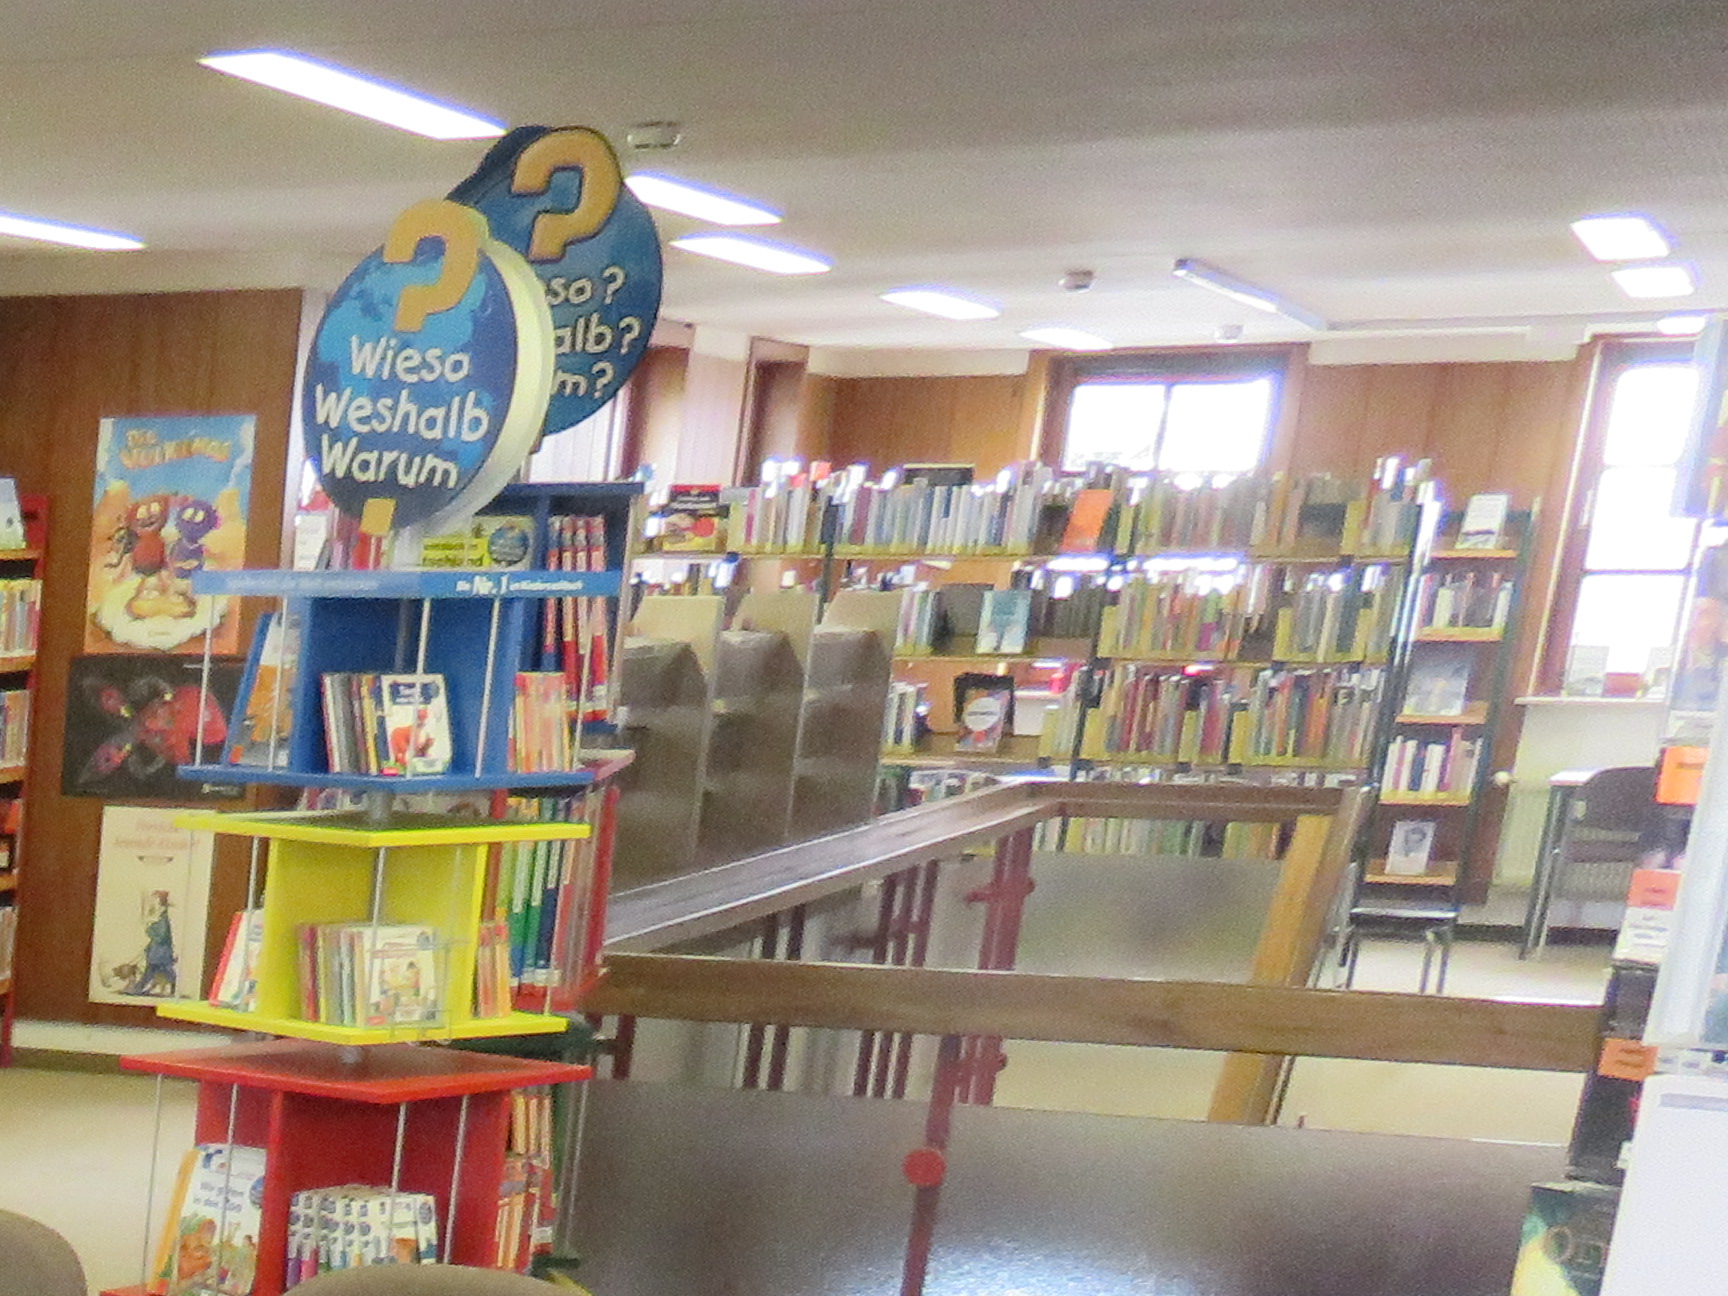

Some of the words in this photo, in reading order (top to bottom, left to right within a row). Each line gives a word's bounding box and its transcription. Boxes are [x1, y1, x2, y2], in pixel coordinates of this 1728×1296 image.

[349, 334, 471, 385] Wieso
[314, 383, 491, 444] Weshalb
[321, 435, 461, 490] Warum
